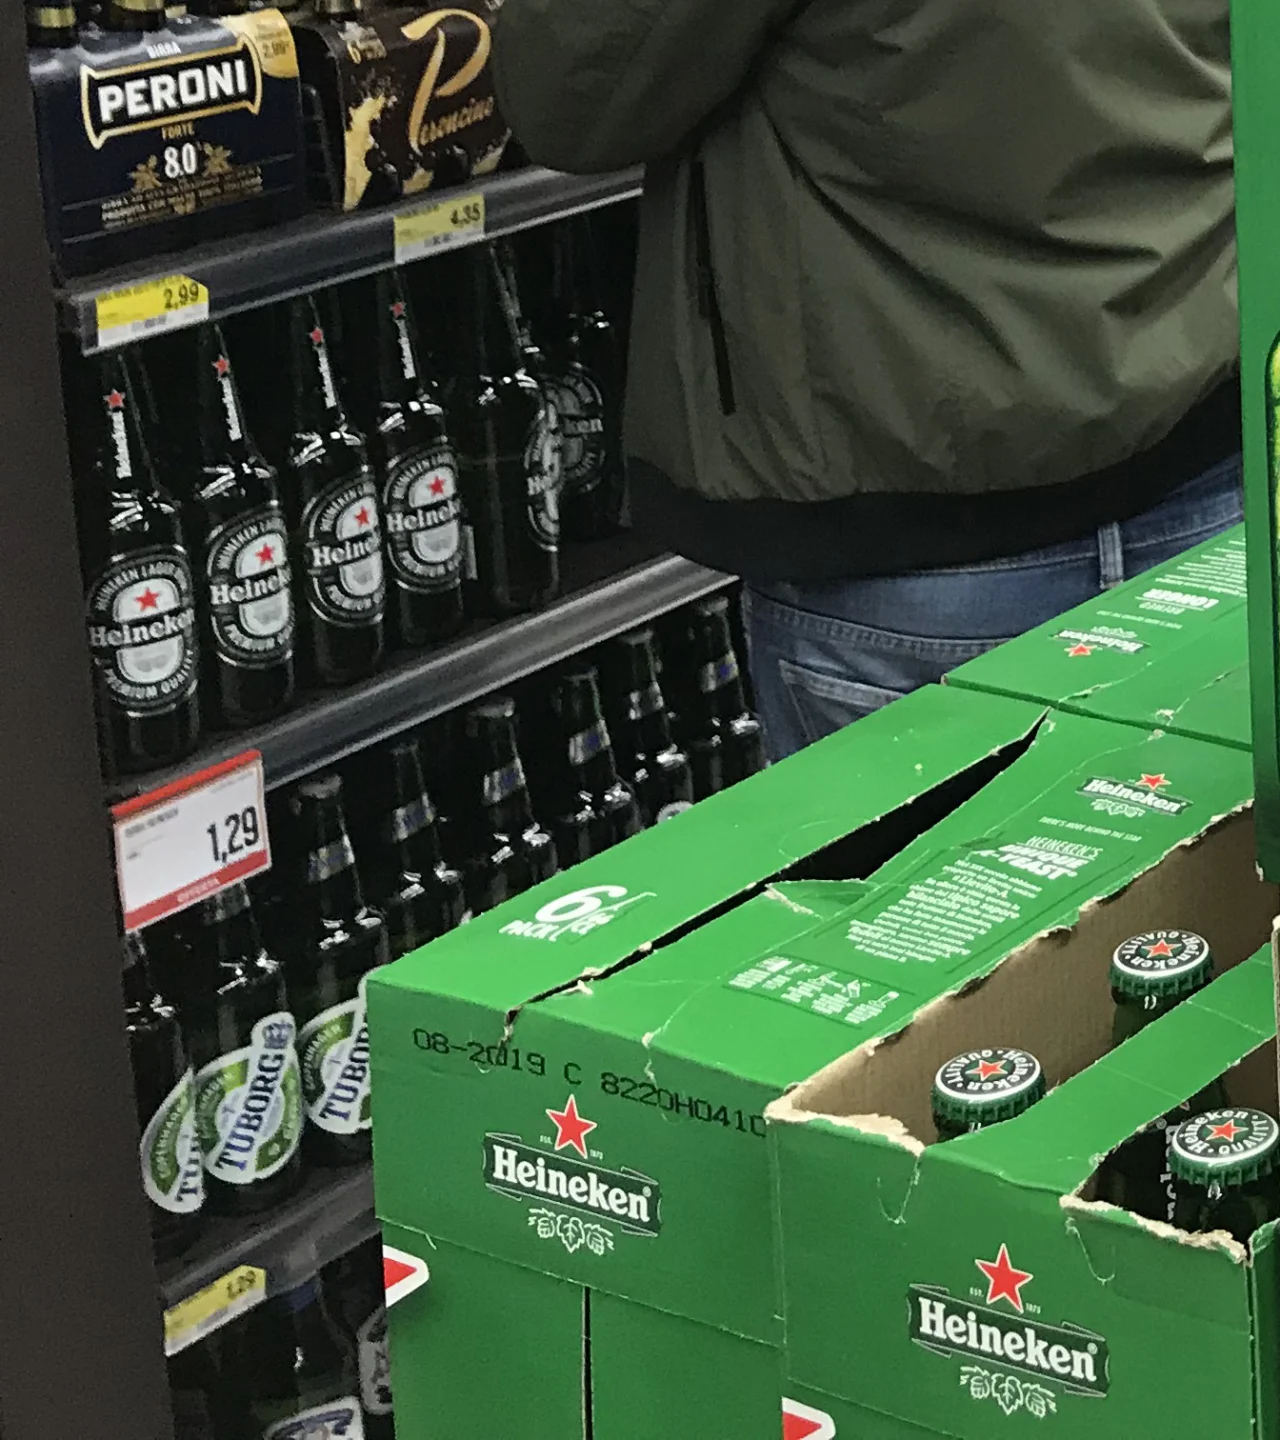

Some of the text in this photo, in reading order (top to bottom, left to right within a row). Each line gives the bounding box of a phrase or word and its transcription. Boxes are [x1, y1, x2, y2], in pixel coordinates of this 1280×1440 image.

[98, 59, 248, 123] PERONI
[163, 283, 200, 308] 2,99
[1083, 779, 1184, 813] Heineken
[206, 806, 259, 864] 1,29
[1026, 835, 1103, 859] HEINEKEN'S
[535, 885, 628, 923] 6
[1139, 936, 1208, 970] Heineken
[412, 1027, 582, 1085] 08-2019 C
[966, 1050, 1040, 1091] Heineken
[214, 1053, 286, 1171] TUBORG
[1179, 1110, 1249, 1153] Heineken
[1218, 1116, 1270, 1154] QUALITY
[492, 1144, 651, 1222] Heineken
[918, 1297, 1098, 1382] Heineken
